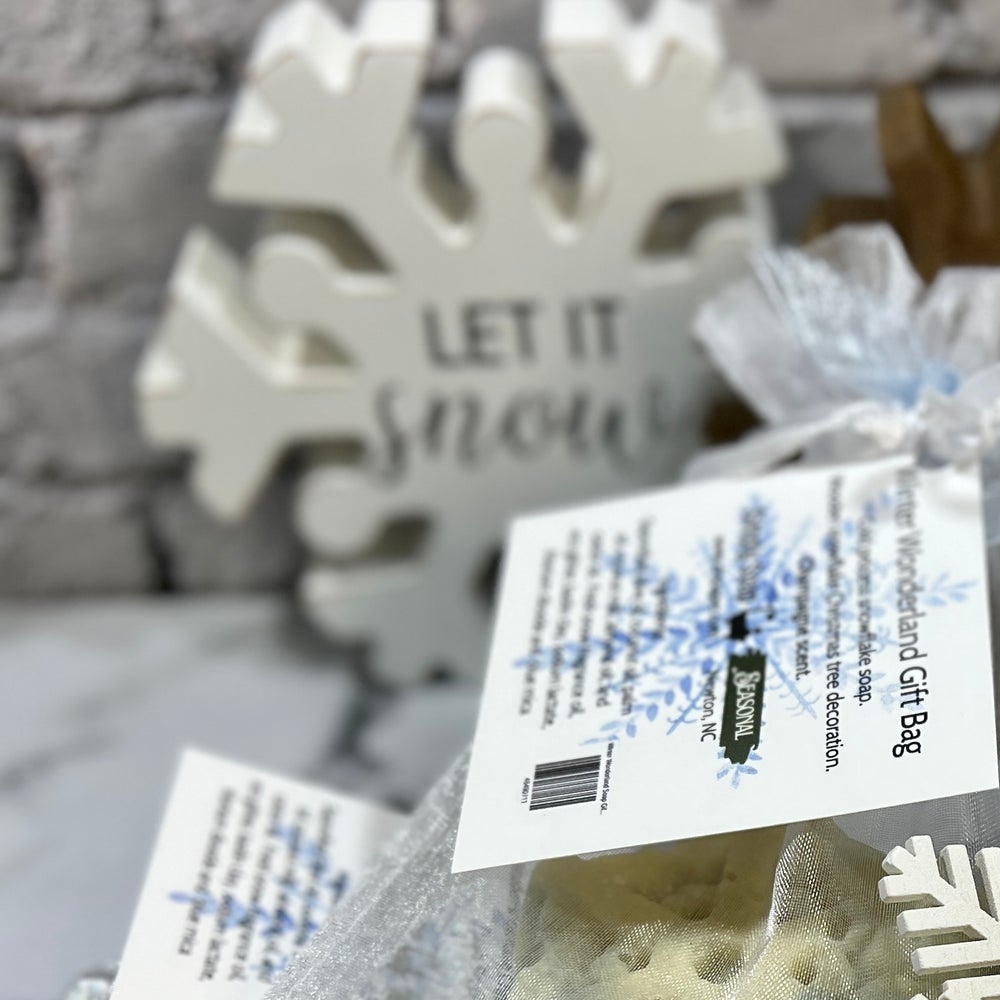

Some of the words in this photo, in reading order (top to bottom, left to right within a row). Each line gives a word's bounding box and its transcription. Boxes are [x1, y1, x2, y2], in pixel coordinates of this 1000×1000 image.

[420, 298, 541, 372] LET
[564, 297, 624, 366] IT
[896, 530, 927, 662] Wonderland
[795, 639, 812, 682] scent.
[826, 661, 842, 690] tree
[853, 668, 873, 707] soap.
[899, 666, 929, 709] Gift
[700, 722, 718, 743] NC
[825, 692, 846, 773] decoration.
[891, 711, 929, 759] Bag
